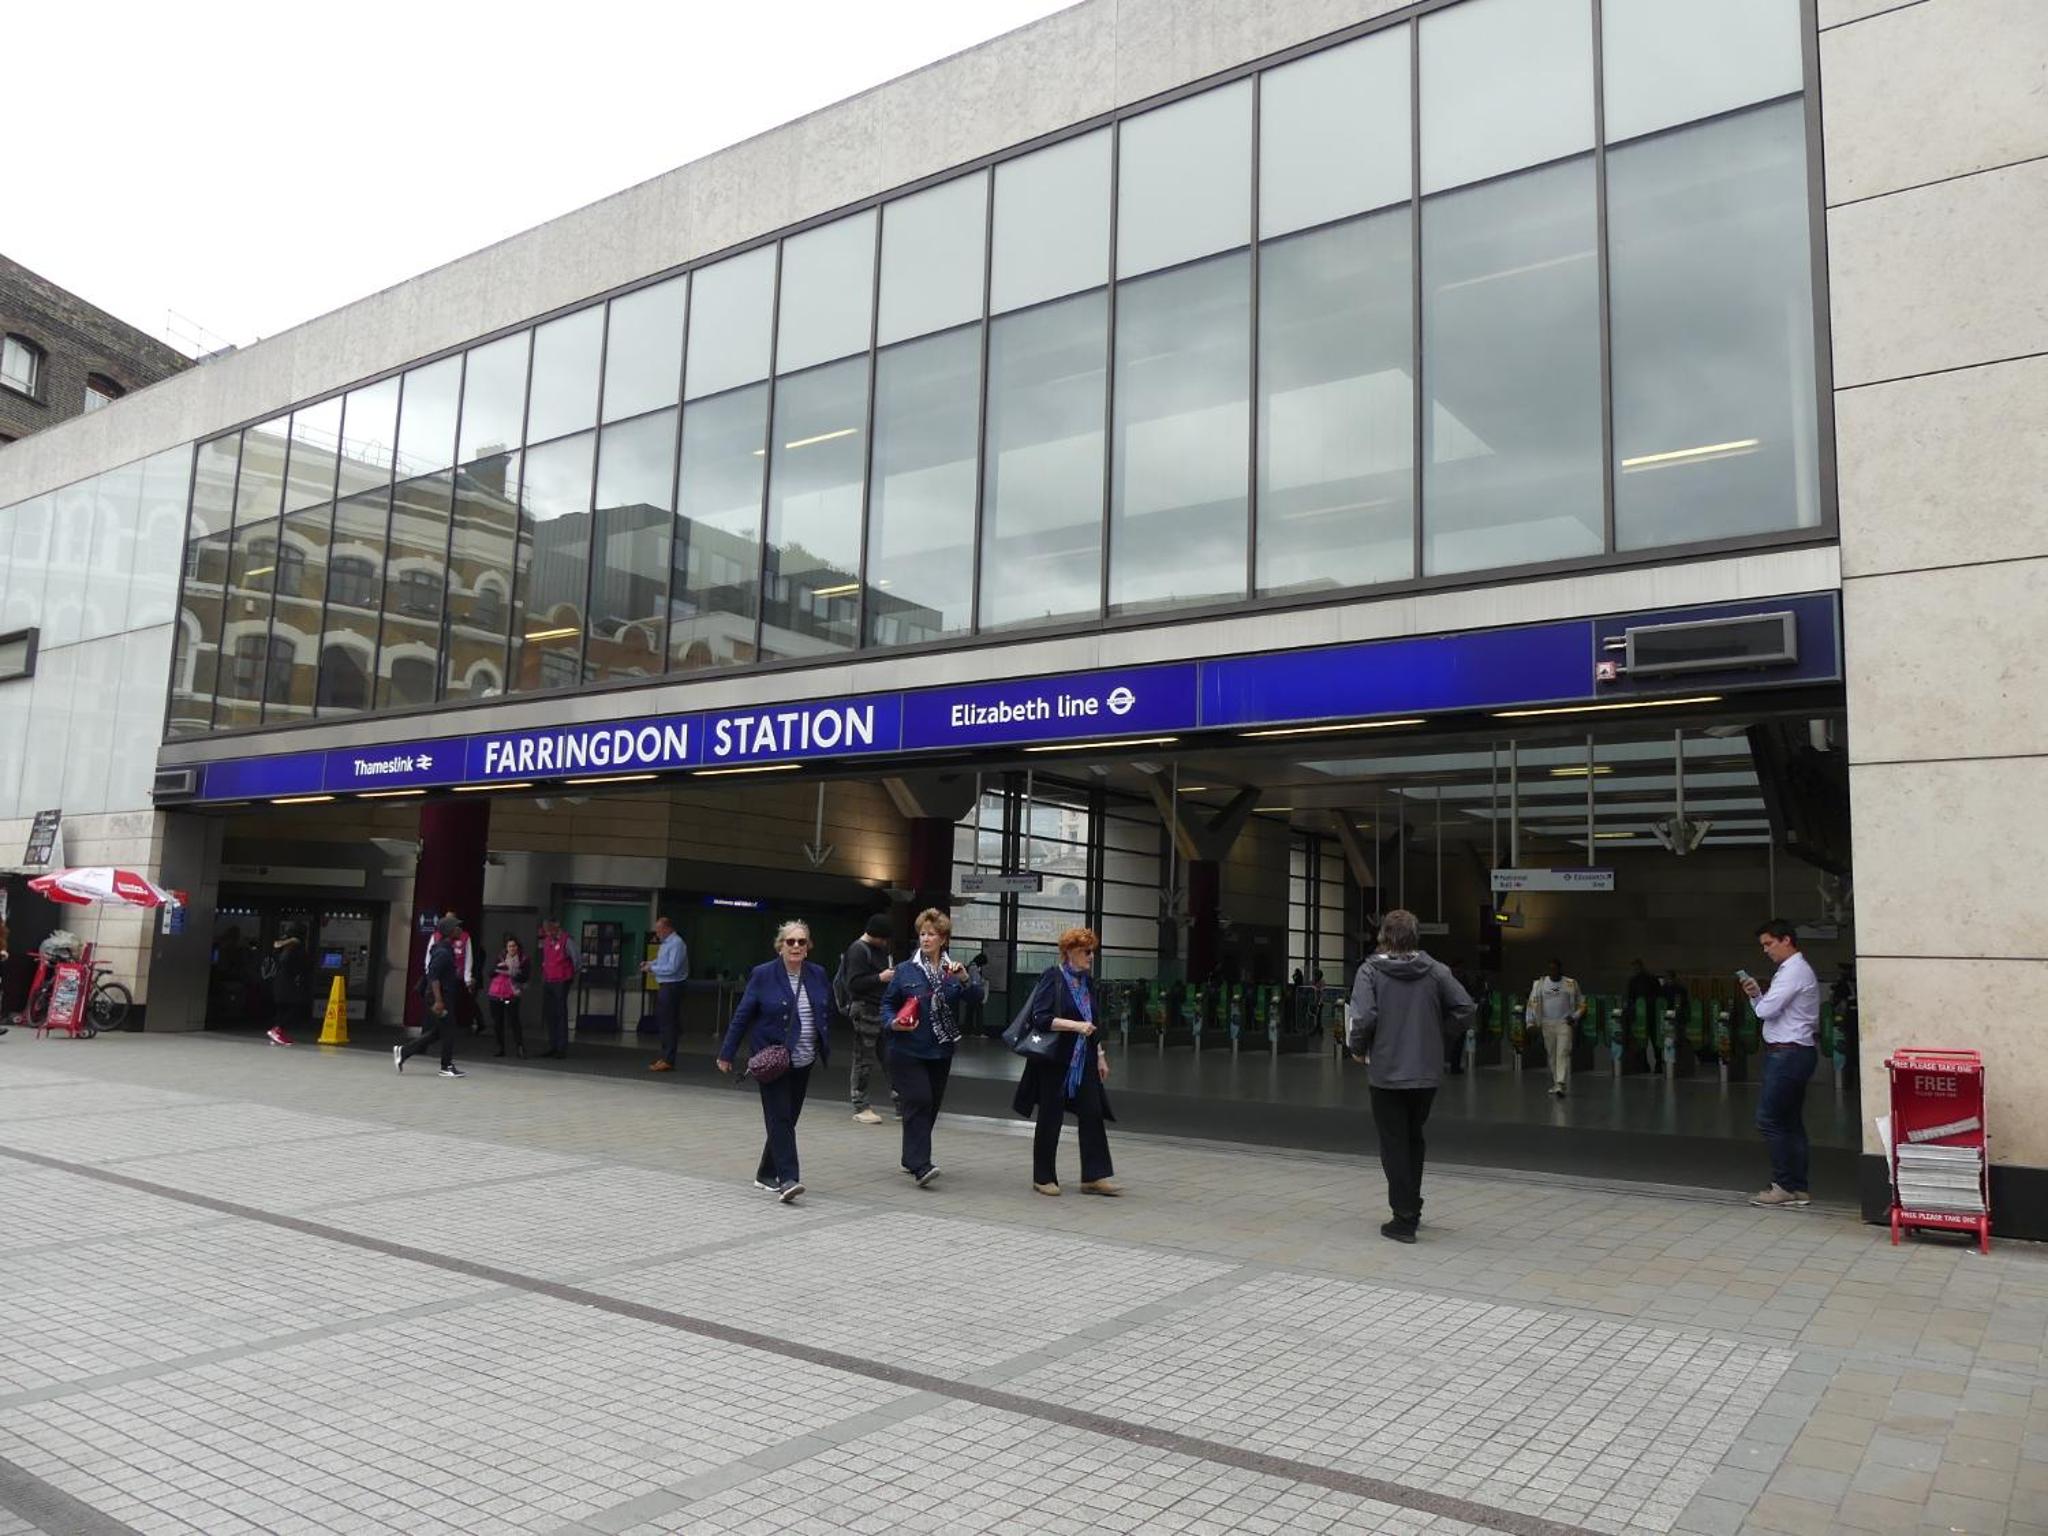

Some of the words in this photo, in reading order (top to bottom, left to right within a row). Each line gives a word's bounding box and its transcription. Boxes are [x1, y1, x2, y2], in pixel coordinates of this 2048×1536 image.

[951, 697, 1049, 727] Elizabeth
[1058, 695, 1098, 718] line
[484, 723, 688, 774] FARRINGDON
[714, 705, 874, 757] STATION
[353, 756, 414, 777] Thameslink
[1909, 1062, 1937, 1071] PLEASE
[1938, 1064, 1955, 1072] TAKE
[1915, 1075, 1957, 1091] FREE
[1919, 1212, 1943, 1221] PLEASE
[1944, 1214, 1961, 1222] TAKE
